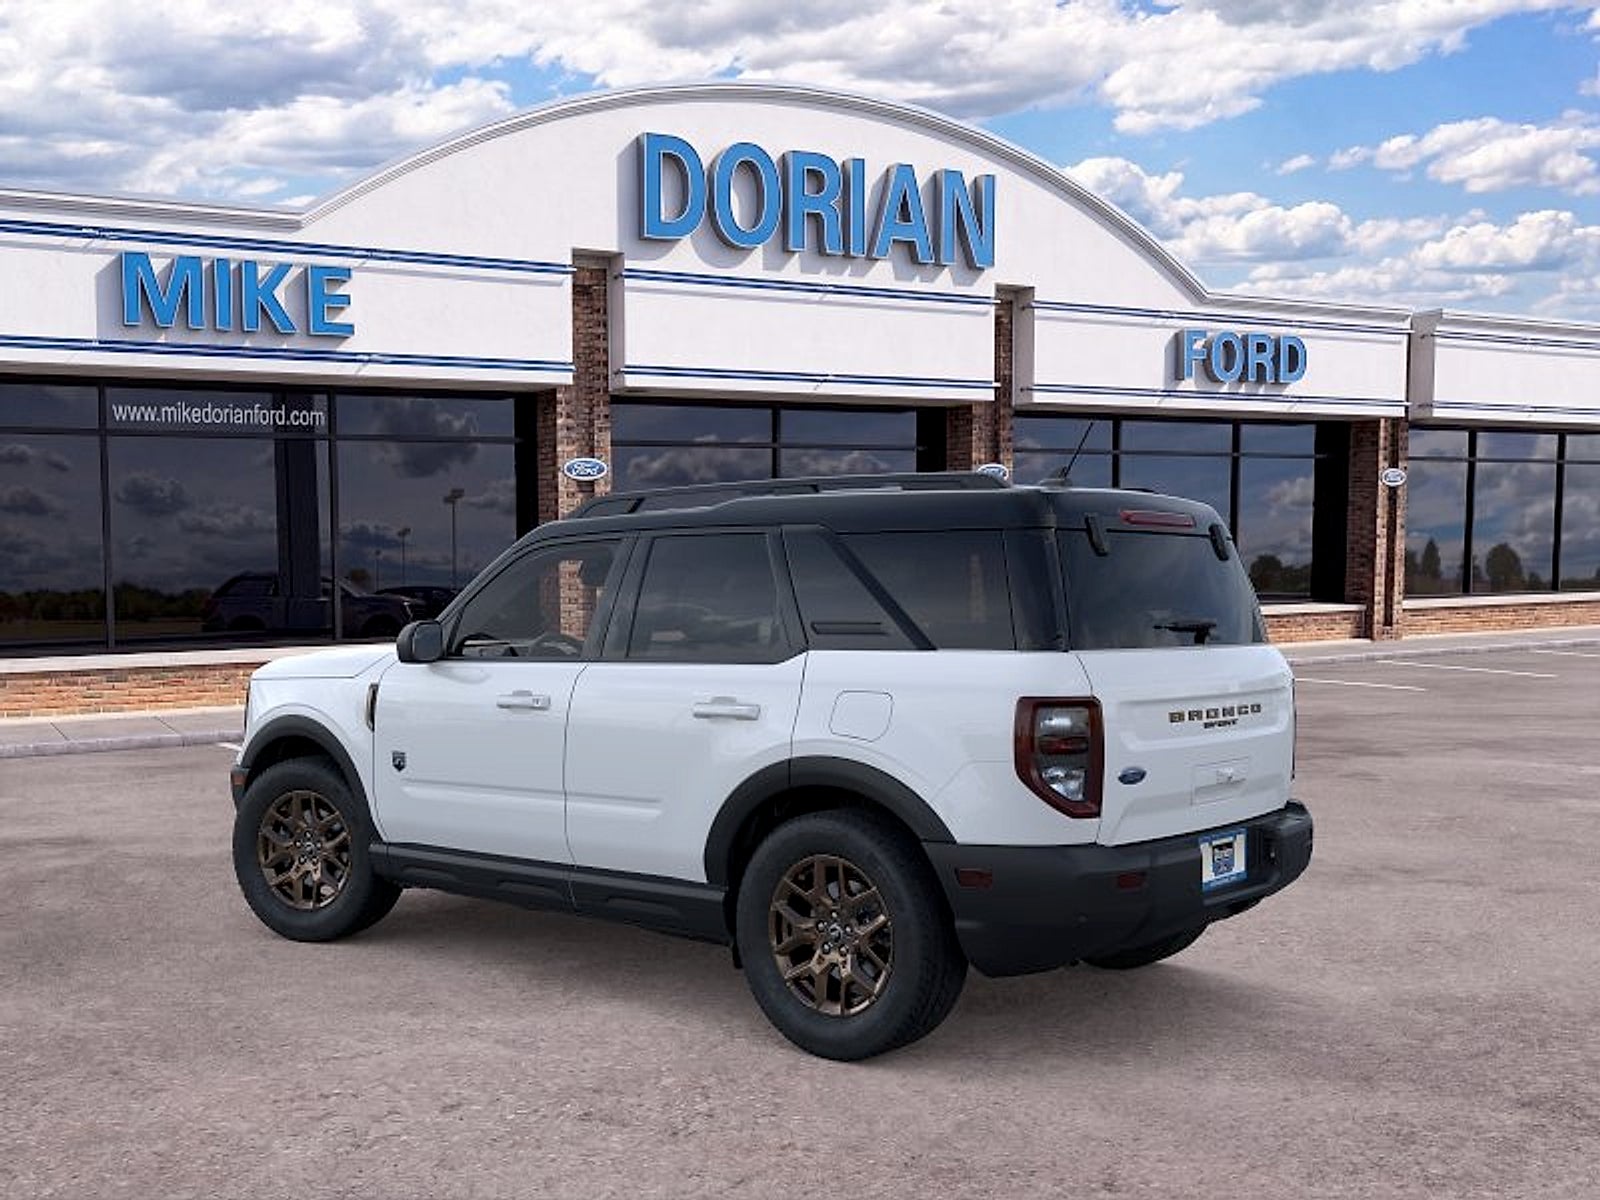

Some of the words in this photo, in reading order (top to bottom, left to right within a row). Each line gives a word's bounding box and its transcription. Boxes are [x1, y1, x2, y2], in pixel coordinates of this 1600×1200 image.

[640, 132, 995, 269] DORIAN
[121, 251, 355, 337] MIKE
[1181, 327, 1307, 384] FORD
[112, 402, 325, 427] www.mikedorianford.com
[1168, 703, 1262, 724] BRONCO
